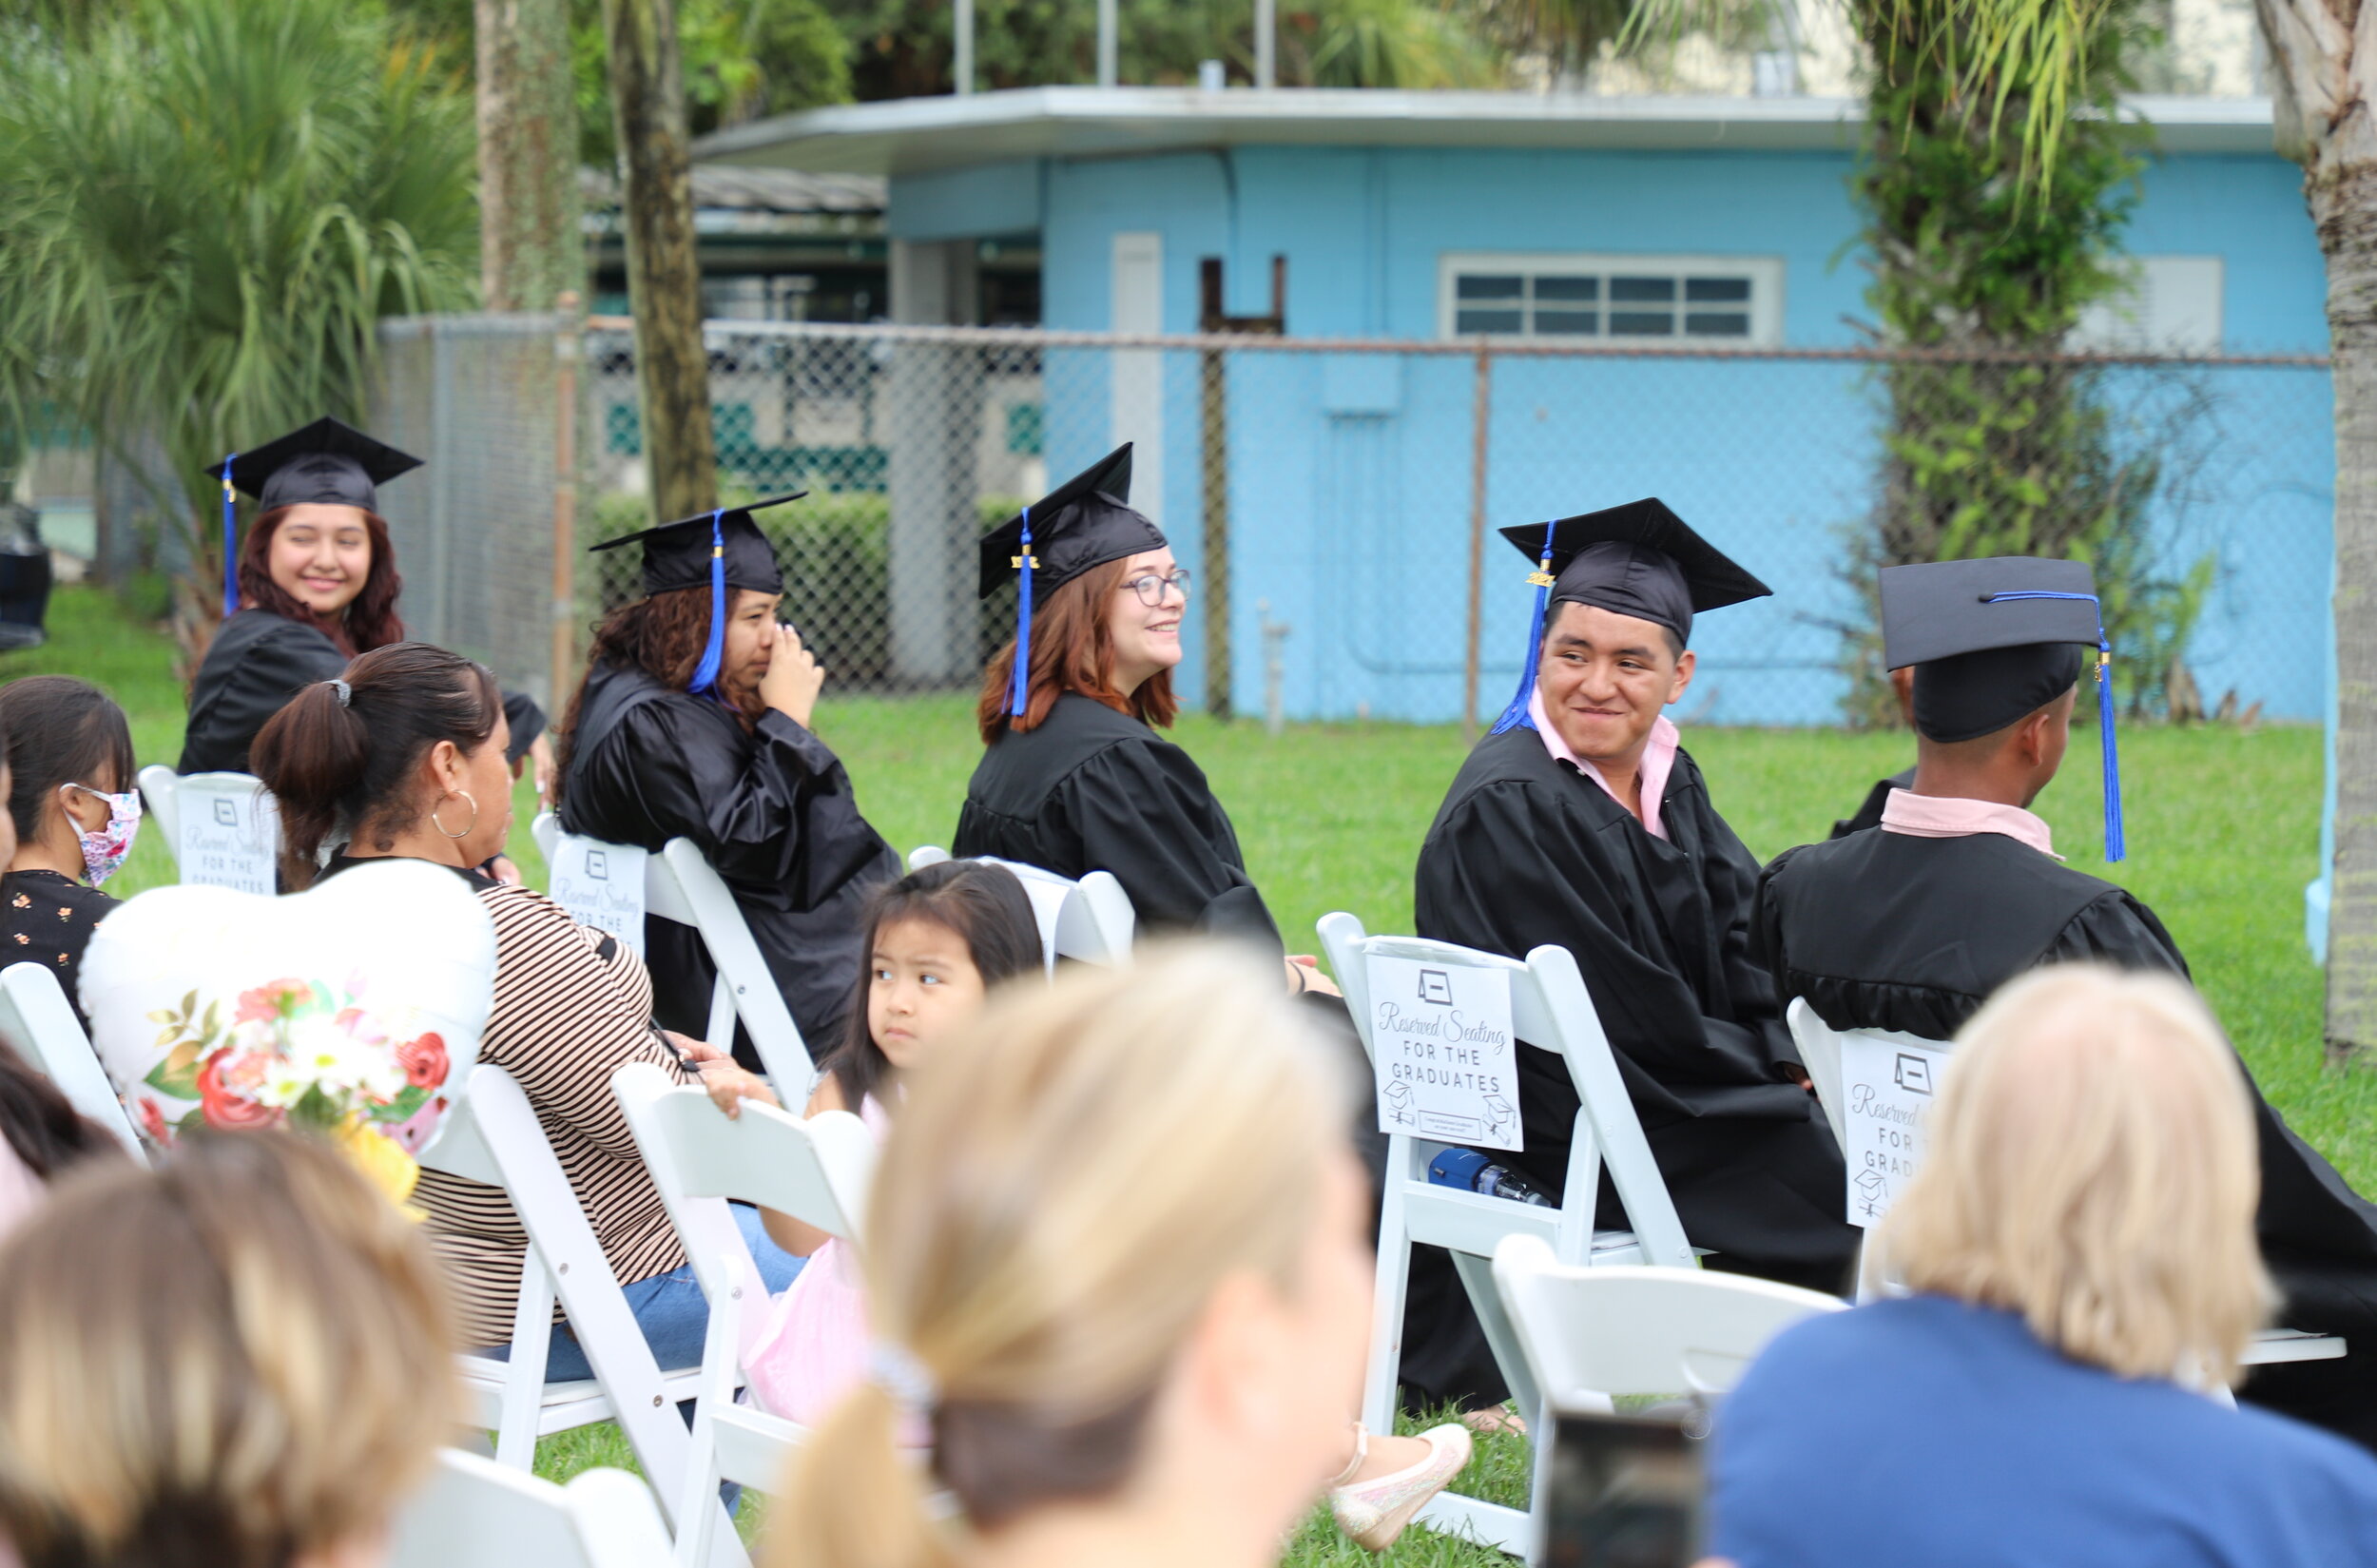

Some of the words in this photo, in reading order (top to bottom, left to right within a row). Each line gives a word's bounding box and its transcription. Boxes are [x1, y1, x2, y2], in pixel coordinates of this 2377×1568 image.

[203, 855, 225, 870] FOR
[231, 858, 253, 875] THE
[600, 883, 640, 922] Seating
[599, 915, 622, 932] THE
[1379, 1001, 1441, 1037] Reserved
[1442, 1009, 1507, 1055] Seating
[1403, 1040, 1437, 1060] FOR
[1444, 1046, 1481, 1066] THE
[1391, 1062, 1499, 1093] GRADUATES
[1851, 1083, 1920, 1127] Reserved
[1878, 1127, 1913, 1152] FOR
